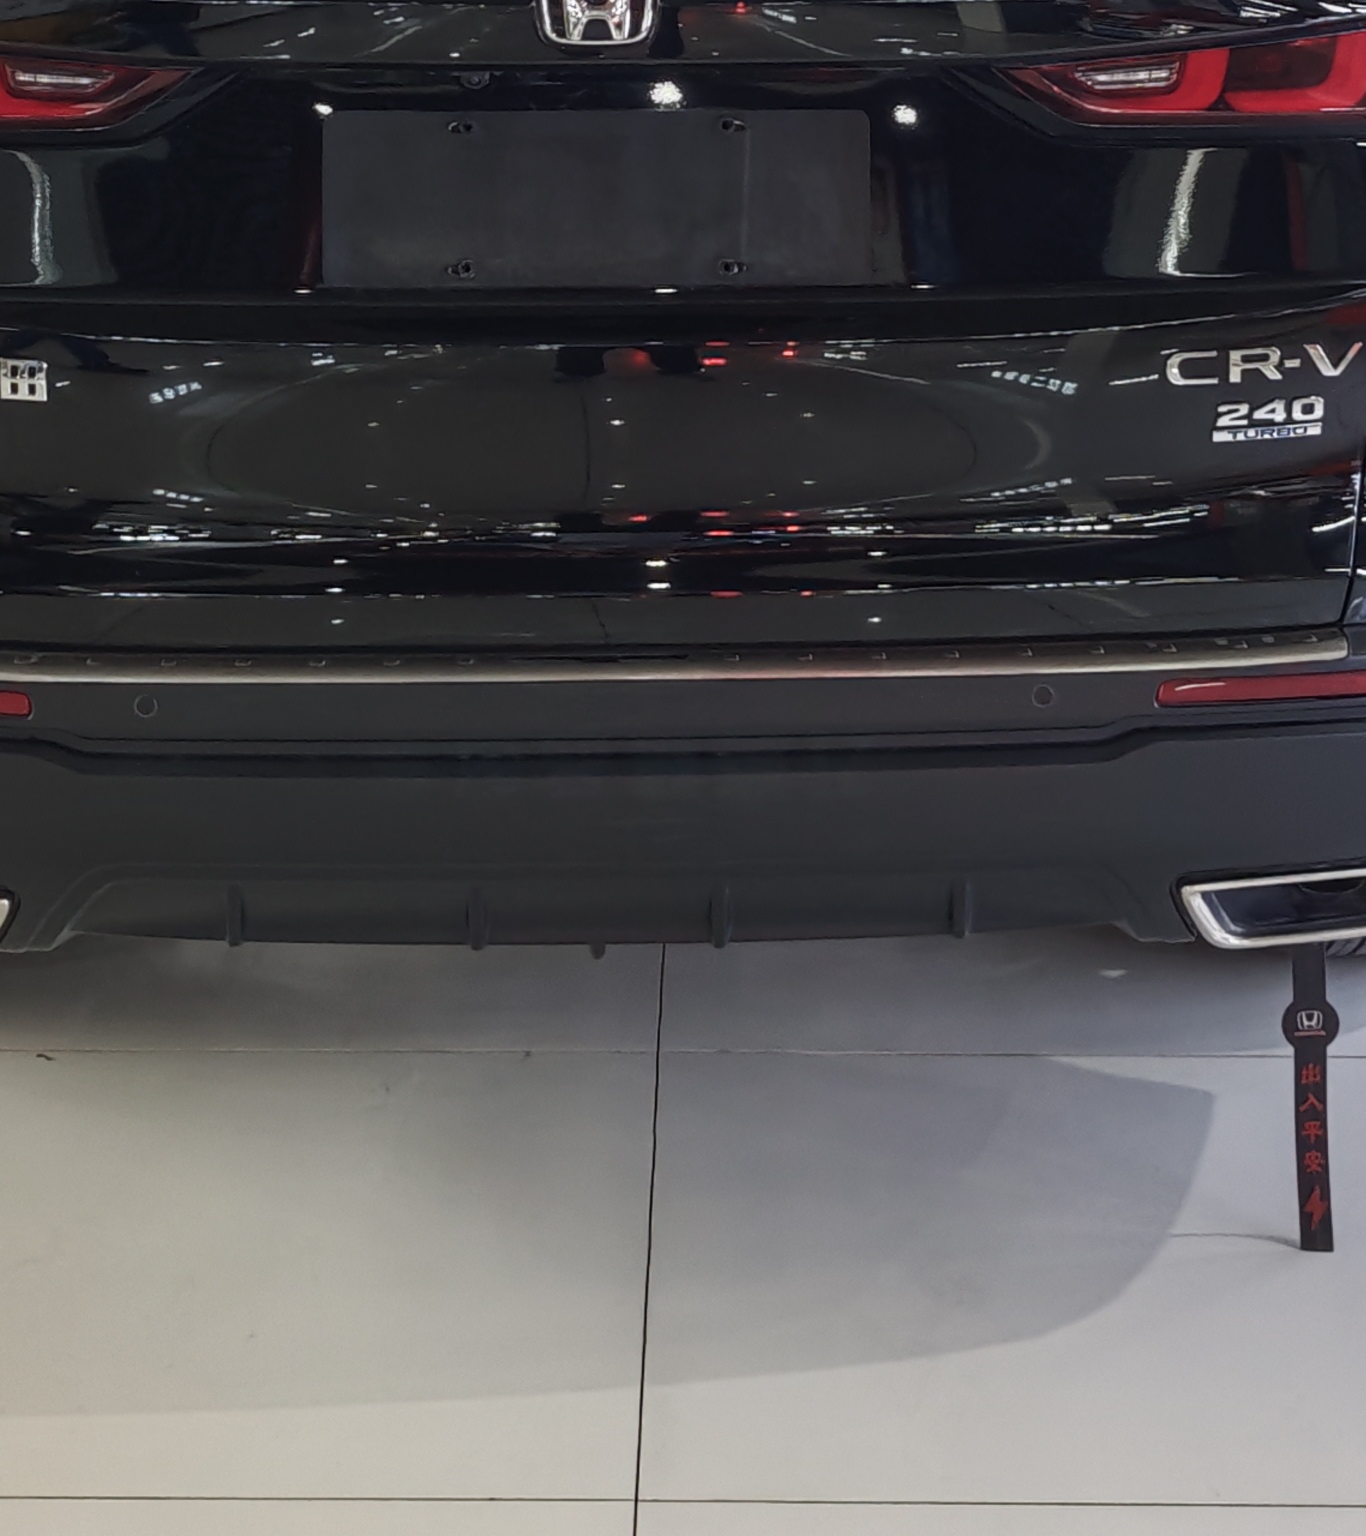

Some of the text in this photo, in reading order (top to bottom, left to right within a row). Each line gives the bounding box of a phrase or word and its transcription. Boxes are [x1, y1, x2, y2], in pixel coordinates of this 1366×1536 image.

[1165, 341, 1364, 386] CR-V
[1215, 395, 1325, 427] 240
[1226, 425, 1309, 440] TURBO
[1298, 1062, 1326, 1174] 出入平安
